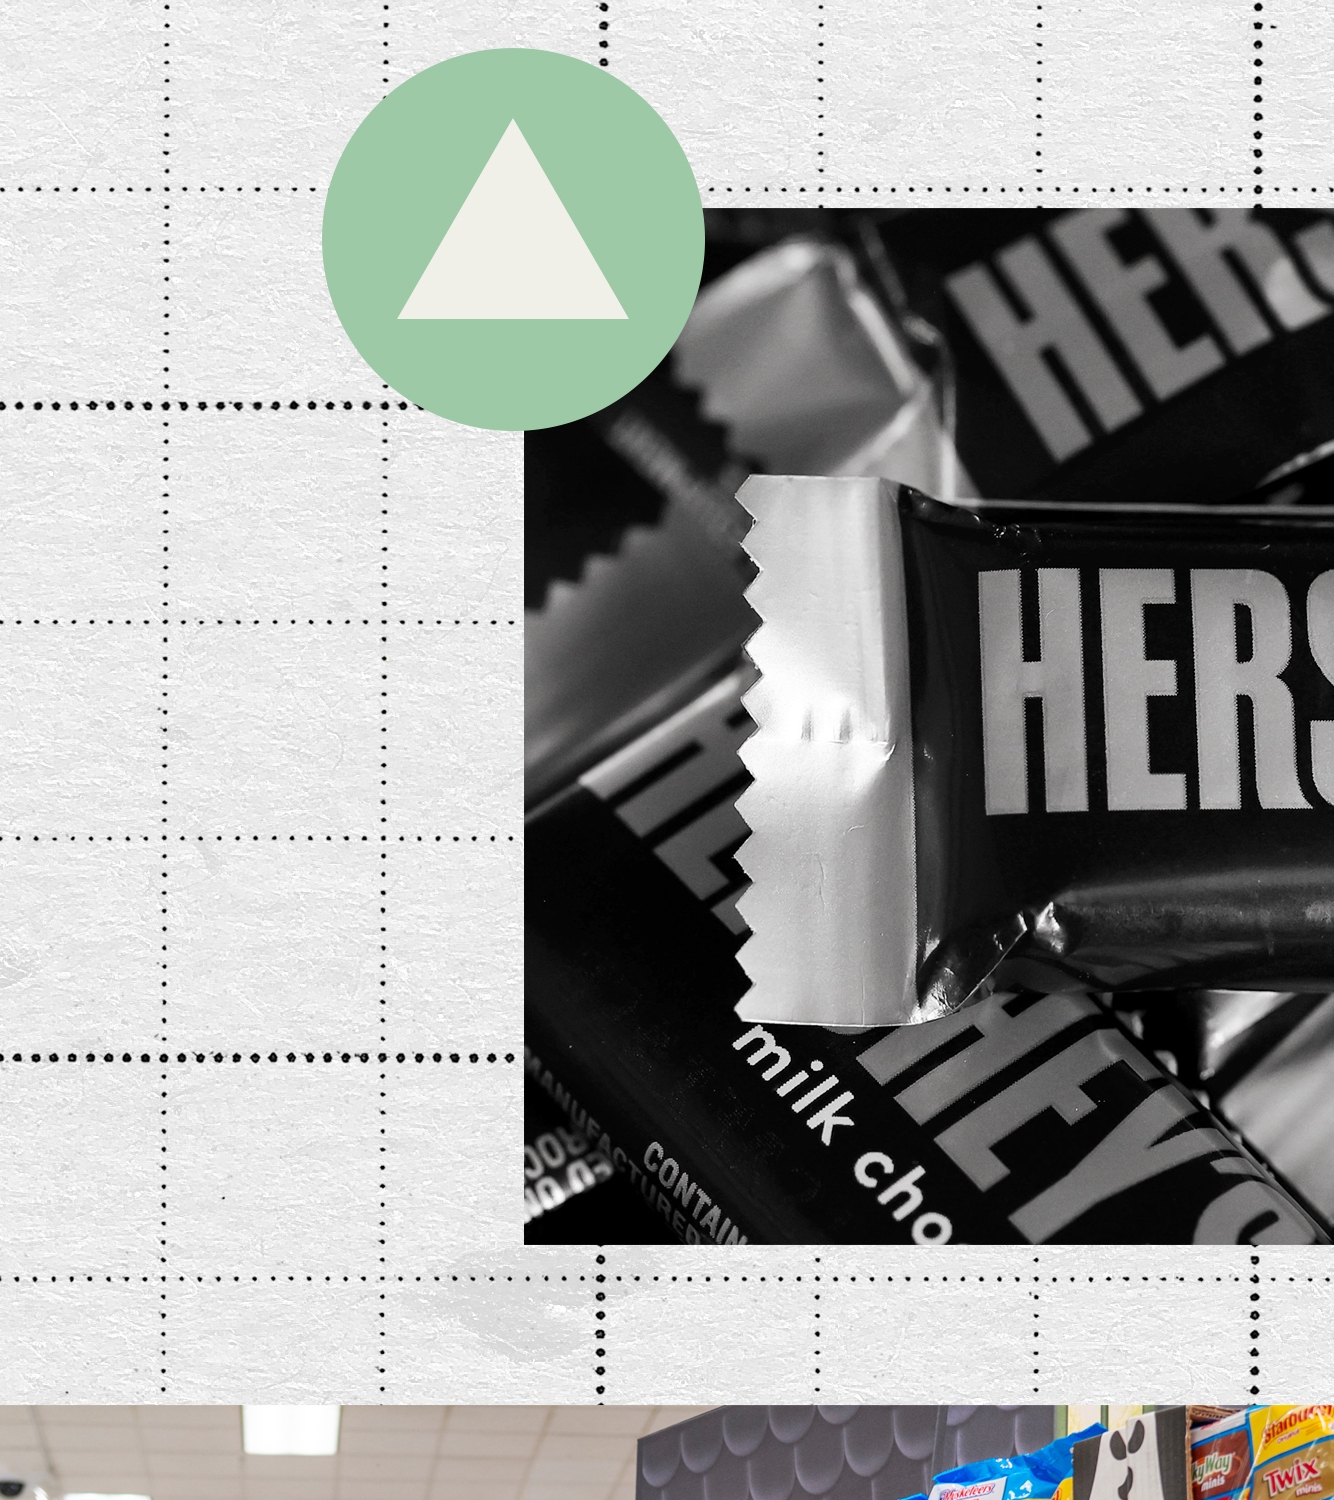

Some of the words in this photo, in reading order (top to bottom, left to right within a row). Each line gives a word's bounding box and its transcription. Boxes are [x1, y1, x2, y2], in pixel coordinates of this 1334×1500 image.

[732, 1024, 856, 1146] milk
[853, 1151, 968, 1245] cho
[1201, 1475, 1225, 1492] minis
[1295, 1484, 1323, 1497] minis
